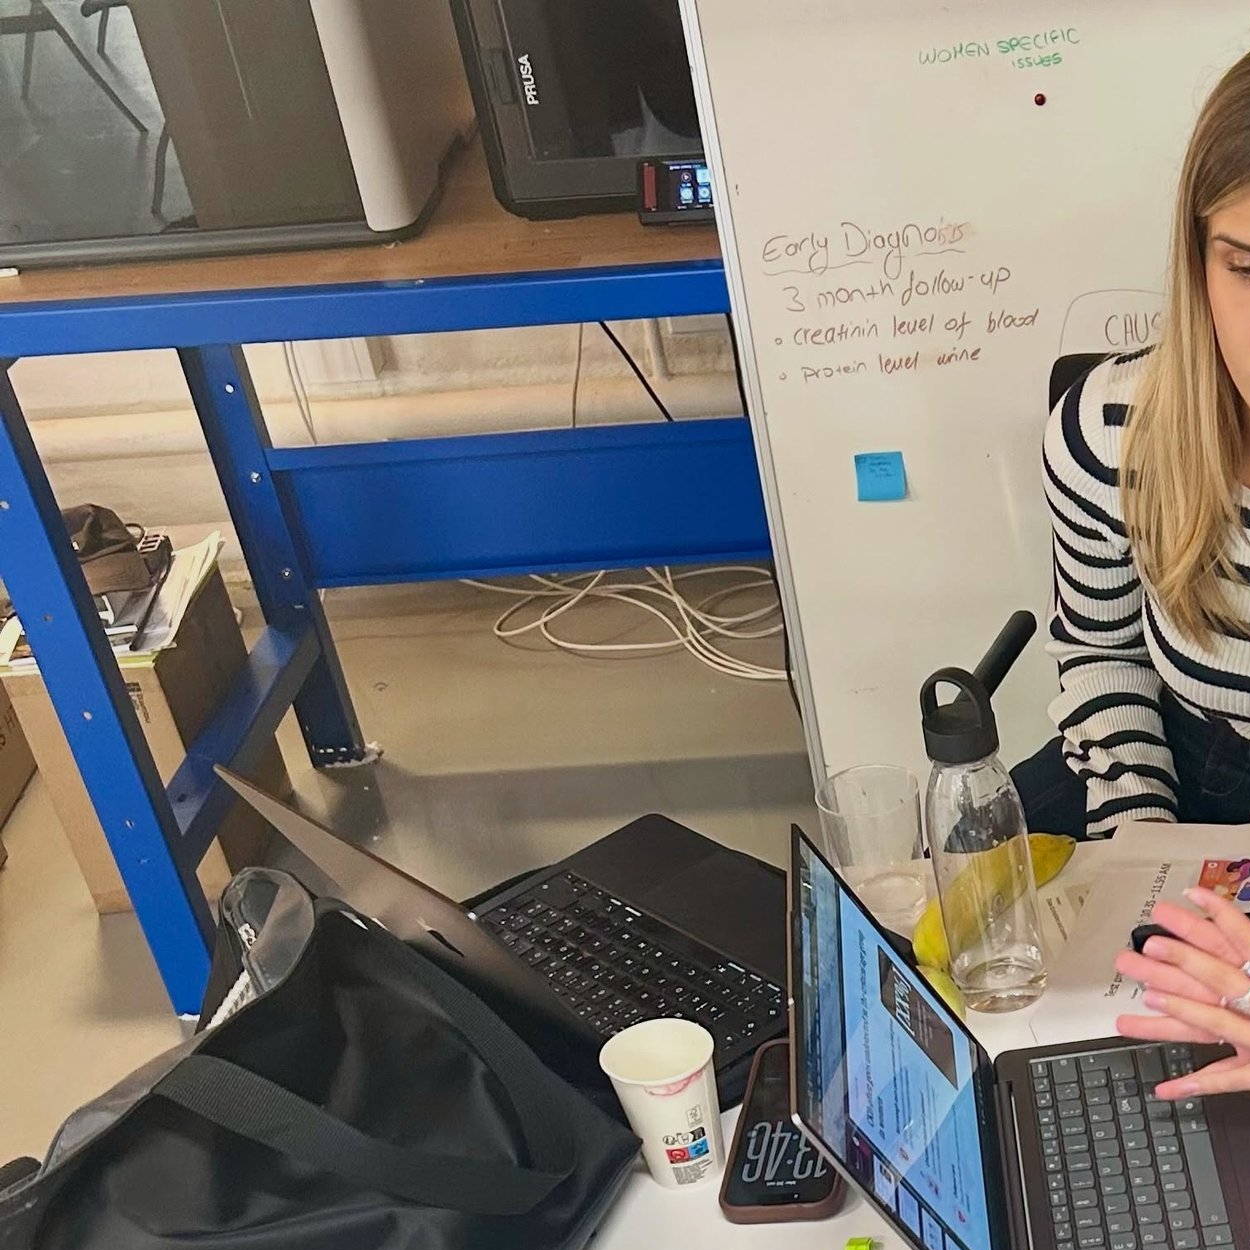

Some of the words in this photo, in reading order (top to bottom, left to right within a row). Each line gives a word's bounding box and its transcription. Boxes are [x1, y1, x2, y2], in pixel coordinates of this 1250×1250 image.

[919, 41, 991, 66] WOMEN
[997, 28, 1081, 54] SPECIFIC
[517, 54, 540, 105] PRUSA
[763, 232, 828, 275] Early
[783, 286, 805, 312] 3
[817, 282, 893, 309] month
[901, 267, 1011, 306] follow-up
[893, 314, 934, 339] level
[945, 312, 971, 339] of
[986, 308, 1039, 334] blood
[879, 351, 920, 374] level
